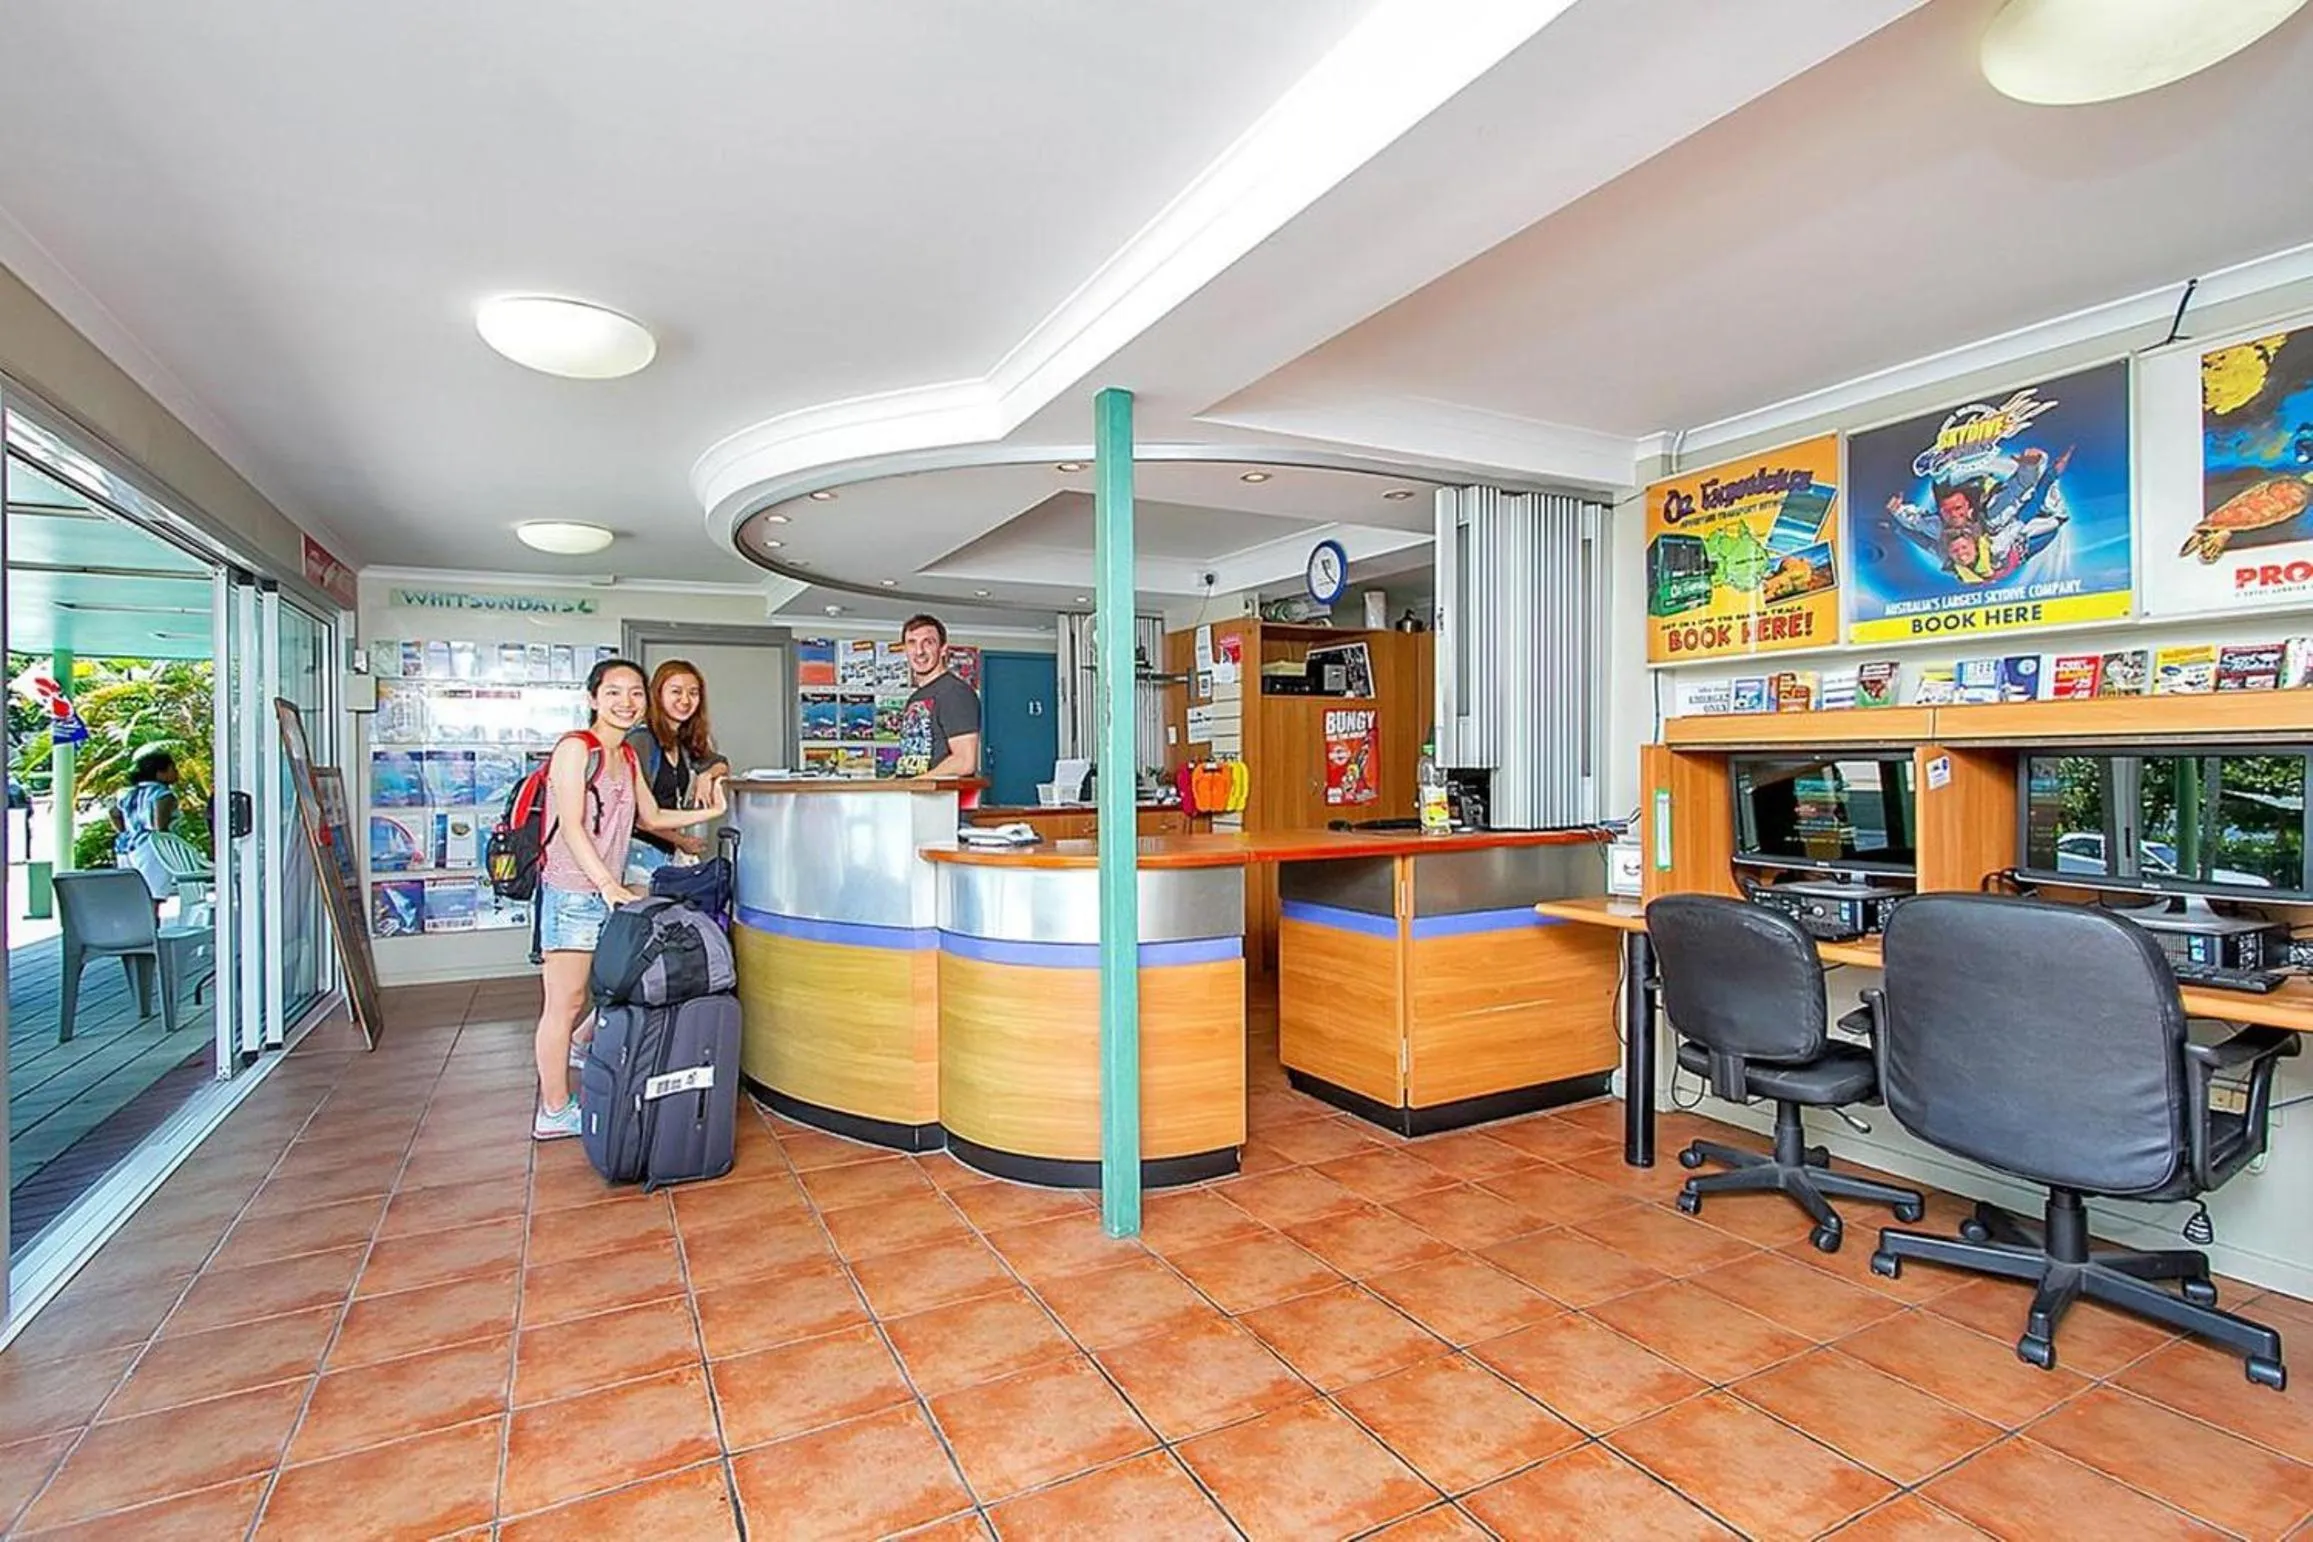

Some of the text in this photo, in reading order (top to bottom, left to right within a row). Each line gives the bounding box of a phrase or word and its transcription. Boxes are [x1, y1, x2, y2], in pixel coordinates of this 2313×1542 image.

[1942, 592, 1983, 609] LARGEST
[1984, 586, 2026, 603] SKYDIVE
[1912, 604, 2042, 633] BOOK HERE
[1668, 611, 1813, 653] BOOK HERE!
[1029, 700, 1042, 716] 13
[1326, 710, 1376, 733] BUNGY
